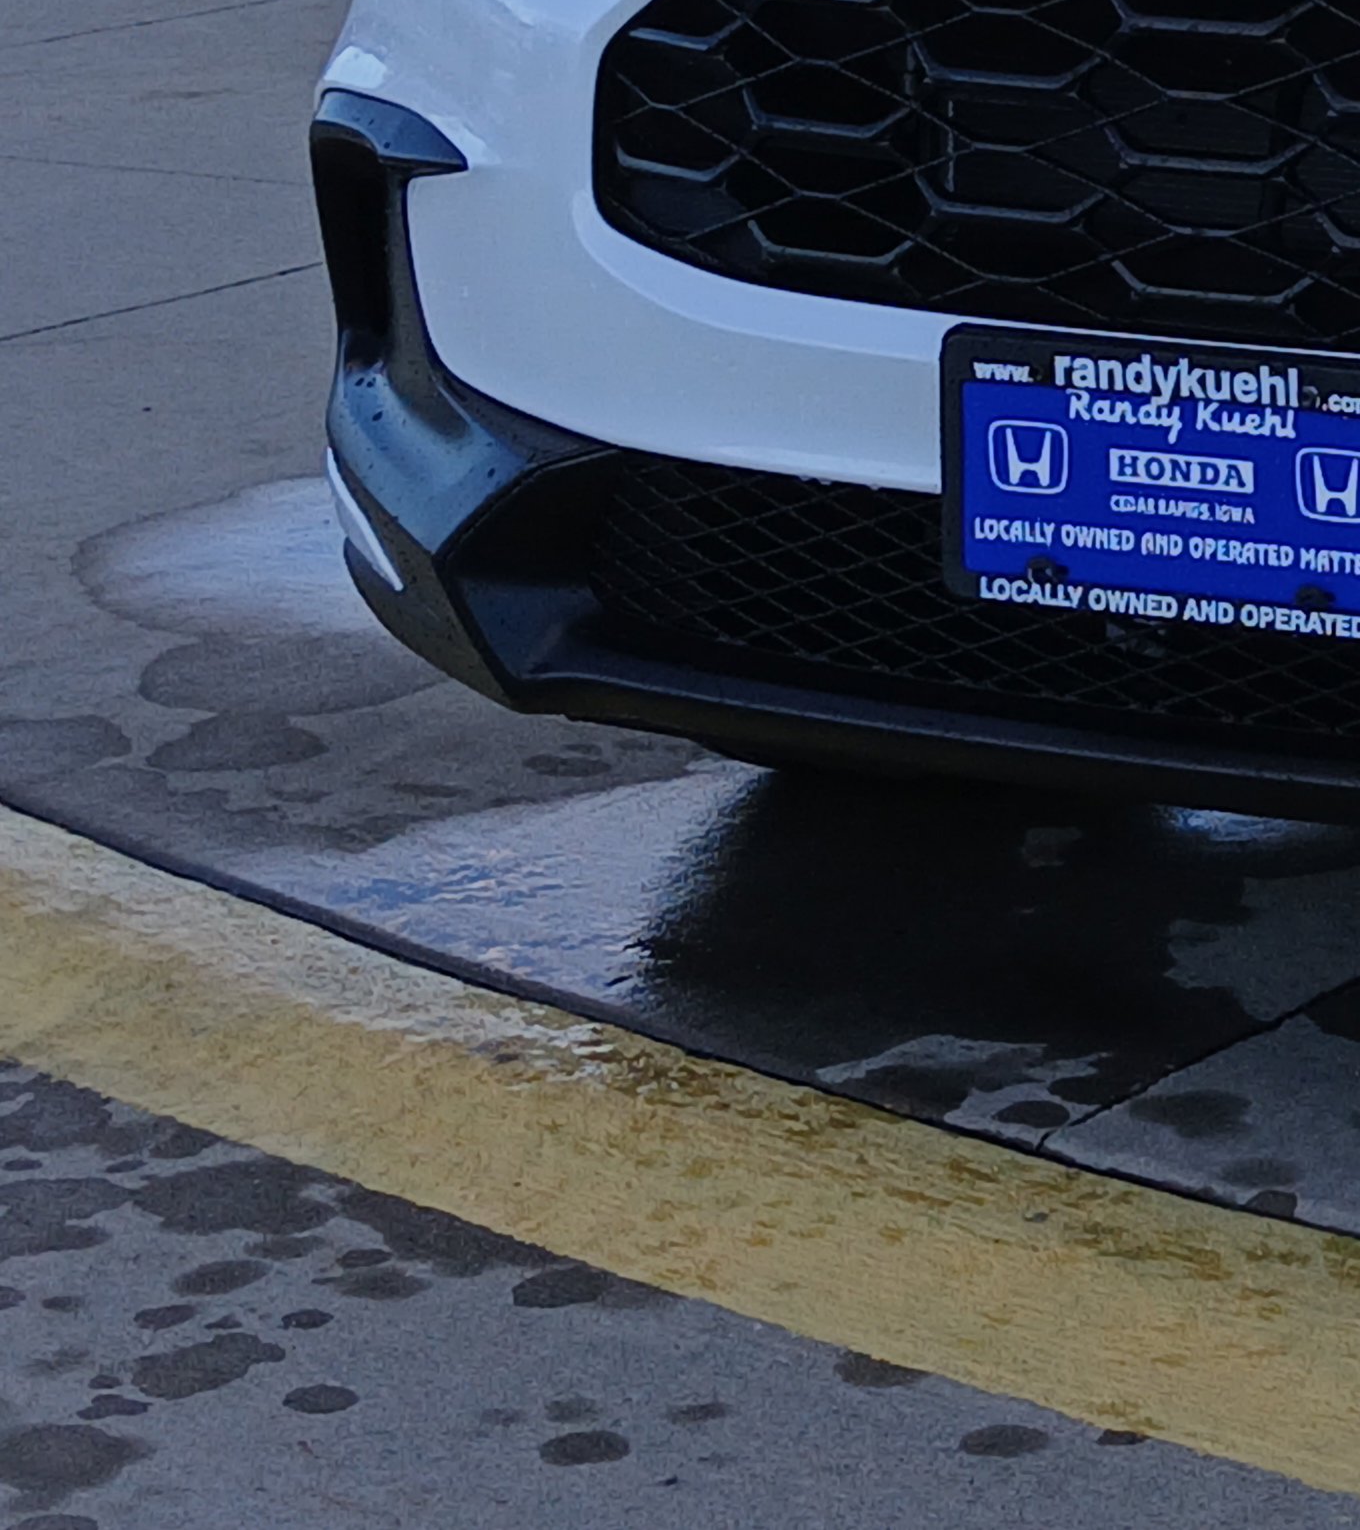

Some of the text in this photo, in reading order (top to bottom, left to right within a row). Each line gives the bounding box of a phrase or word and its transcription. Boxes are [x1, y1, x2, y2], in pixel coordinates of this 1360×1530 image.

[973, 361, 1034, 383] www.
[1054, 354, 1299, 408] randykuehl
[1065, 388, 1297, 445] Randy Kuehl
[1116, 454, 1247, 489] HONDA
[974, 517, 1056, 547] LOCALLY
[1061, 524, 1135, 551] OWNED
[1141, 532, 1183, 557] AND
[1188, 536, 1295, 567] OPERATED
[980, 576, 1083, 609] LOCALLY
[1088, 588, 1178, 619] OWNED
[1182, 598, 1235, 624] AND
